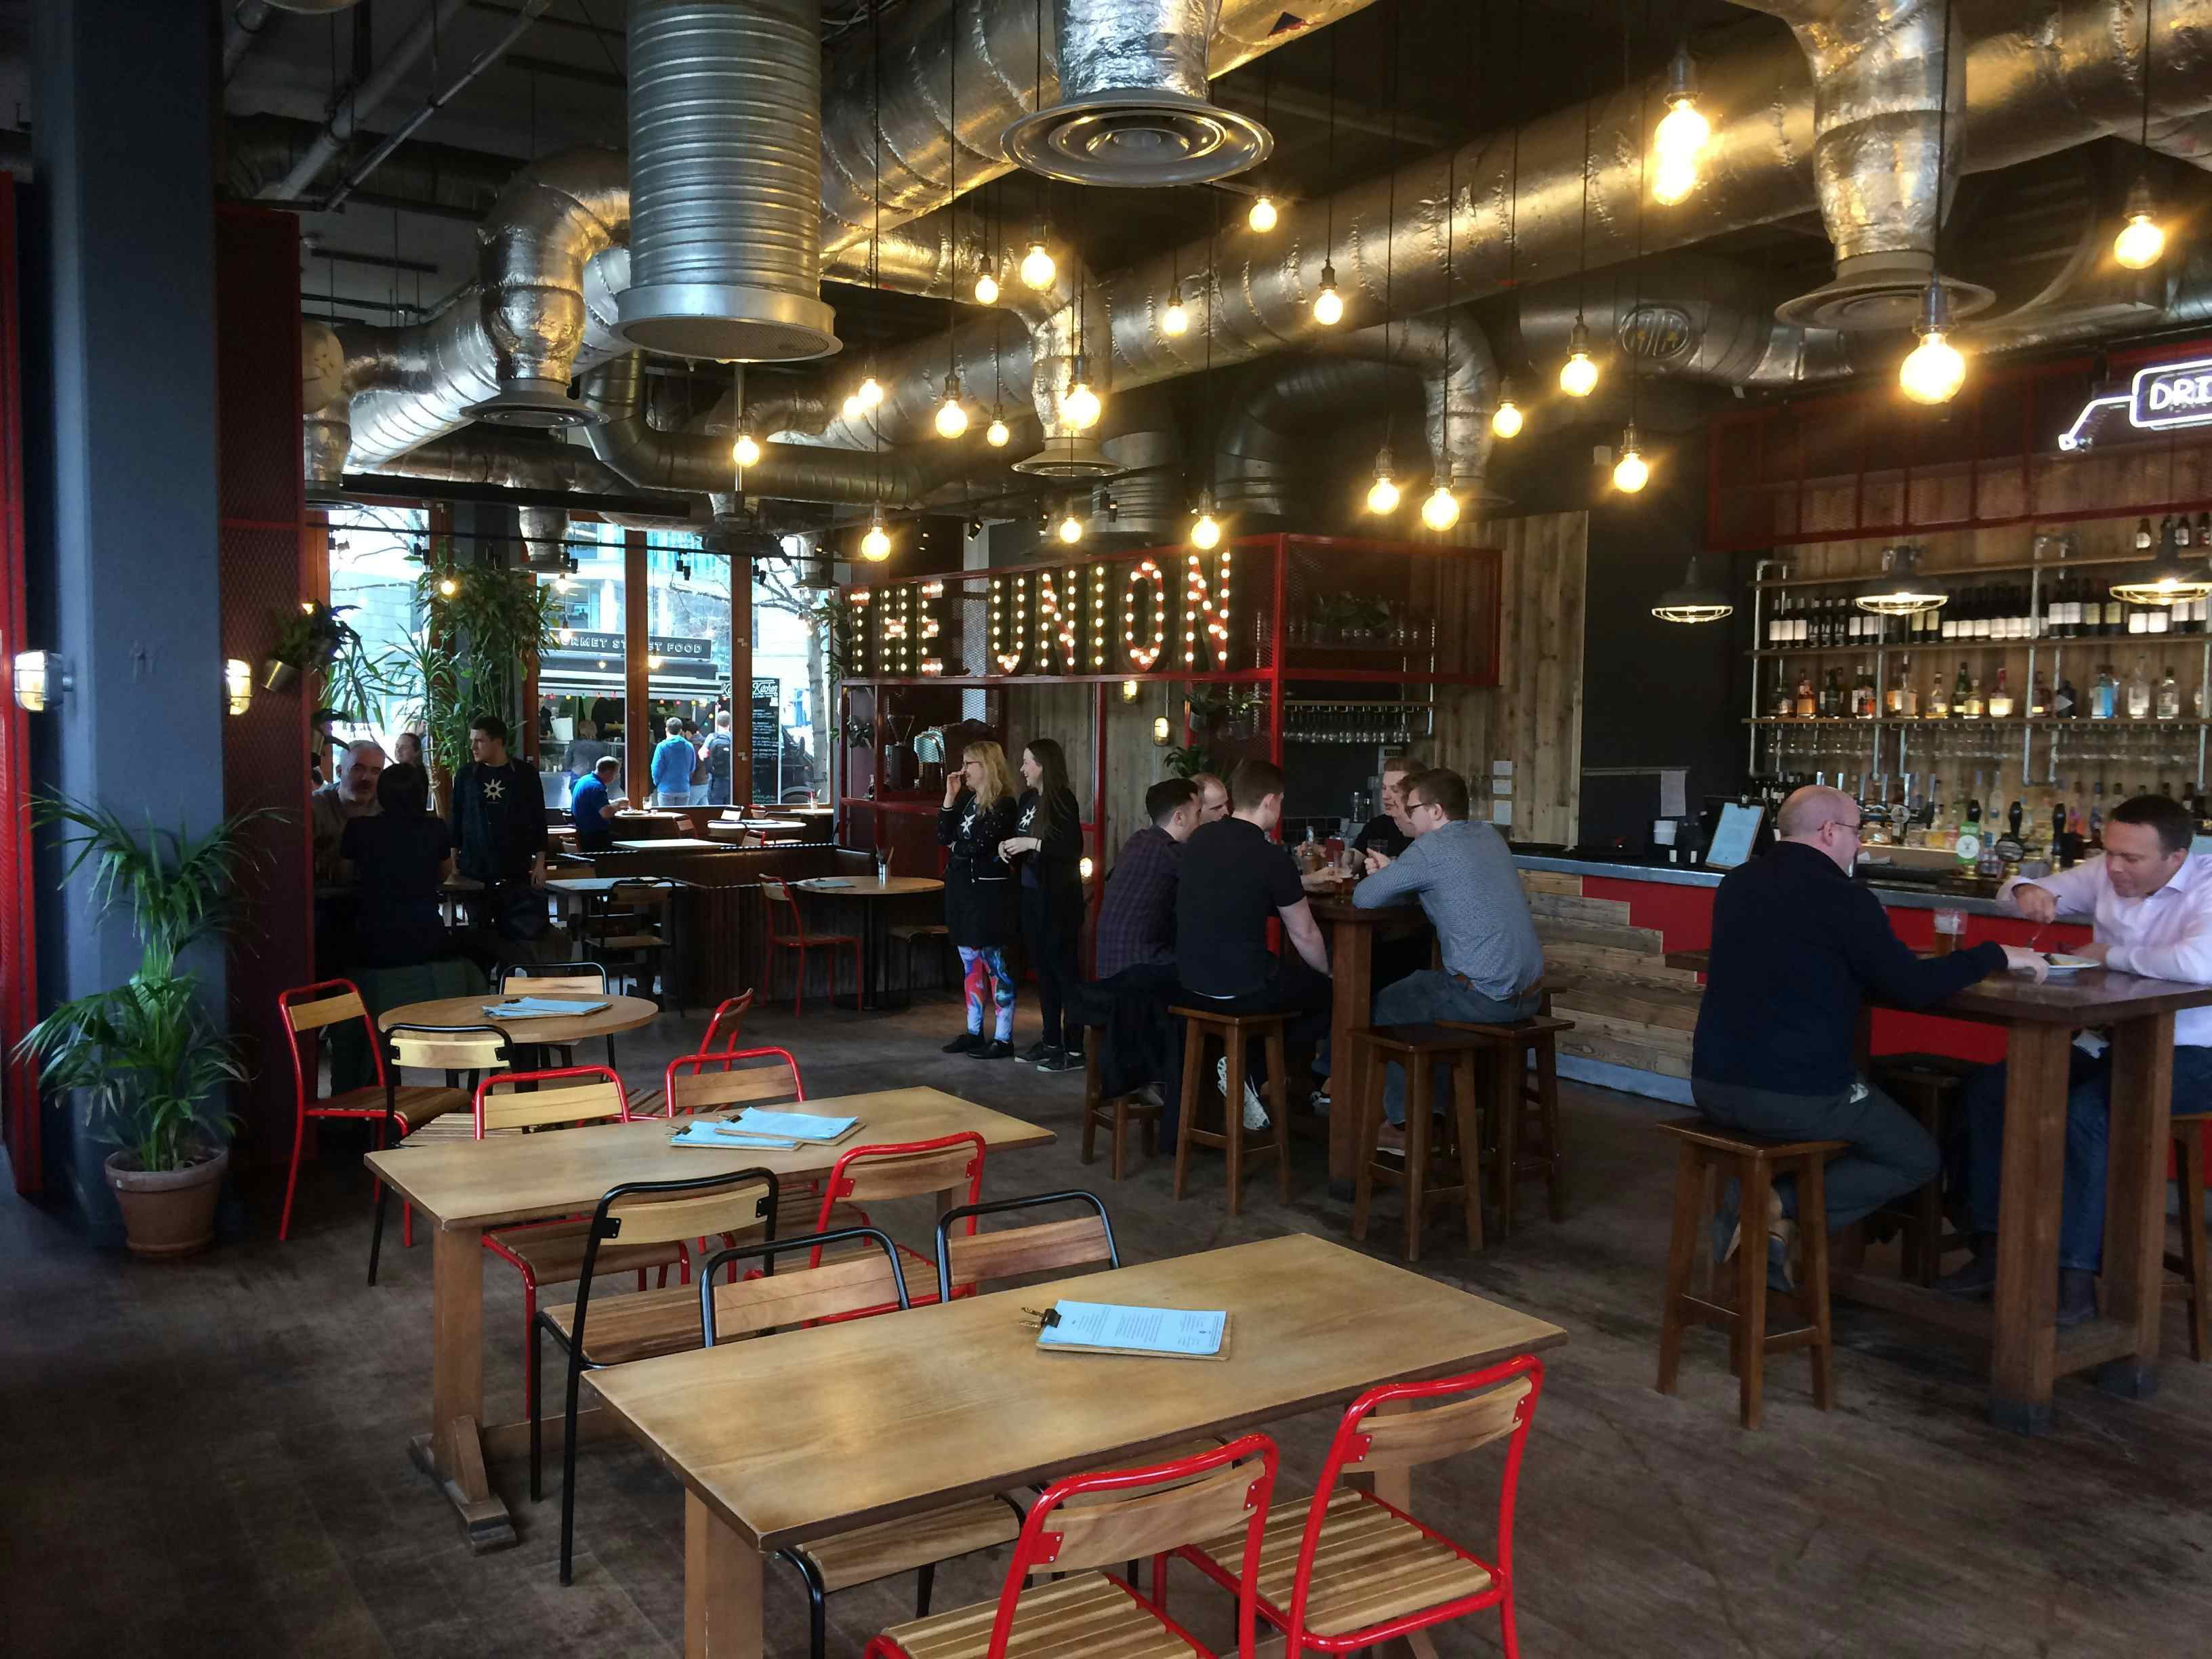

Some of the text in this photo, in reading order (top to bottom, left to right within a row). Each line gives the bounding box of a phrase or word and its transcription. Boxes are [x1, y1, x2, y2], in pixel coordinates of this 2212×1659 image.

[612, 638, 662, 651] STET
[667, 642, 703, 654] FOOD
[844, 550, 1232, 678] THE UNION
